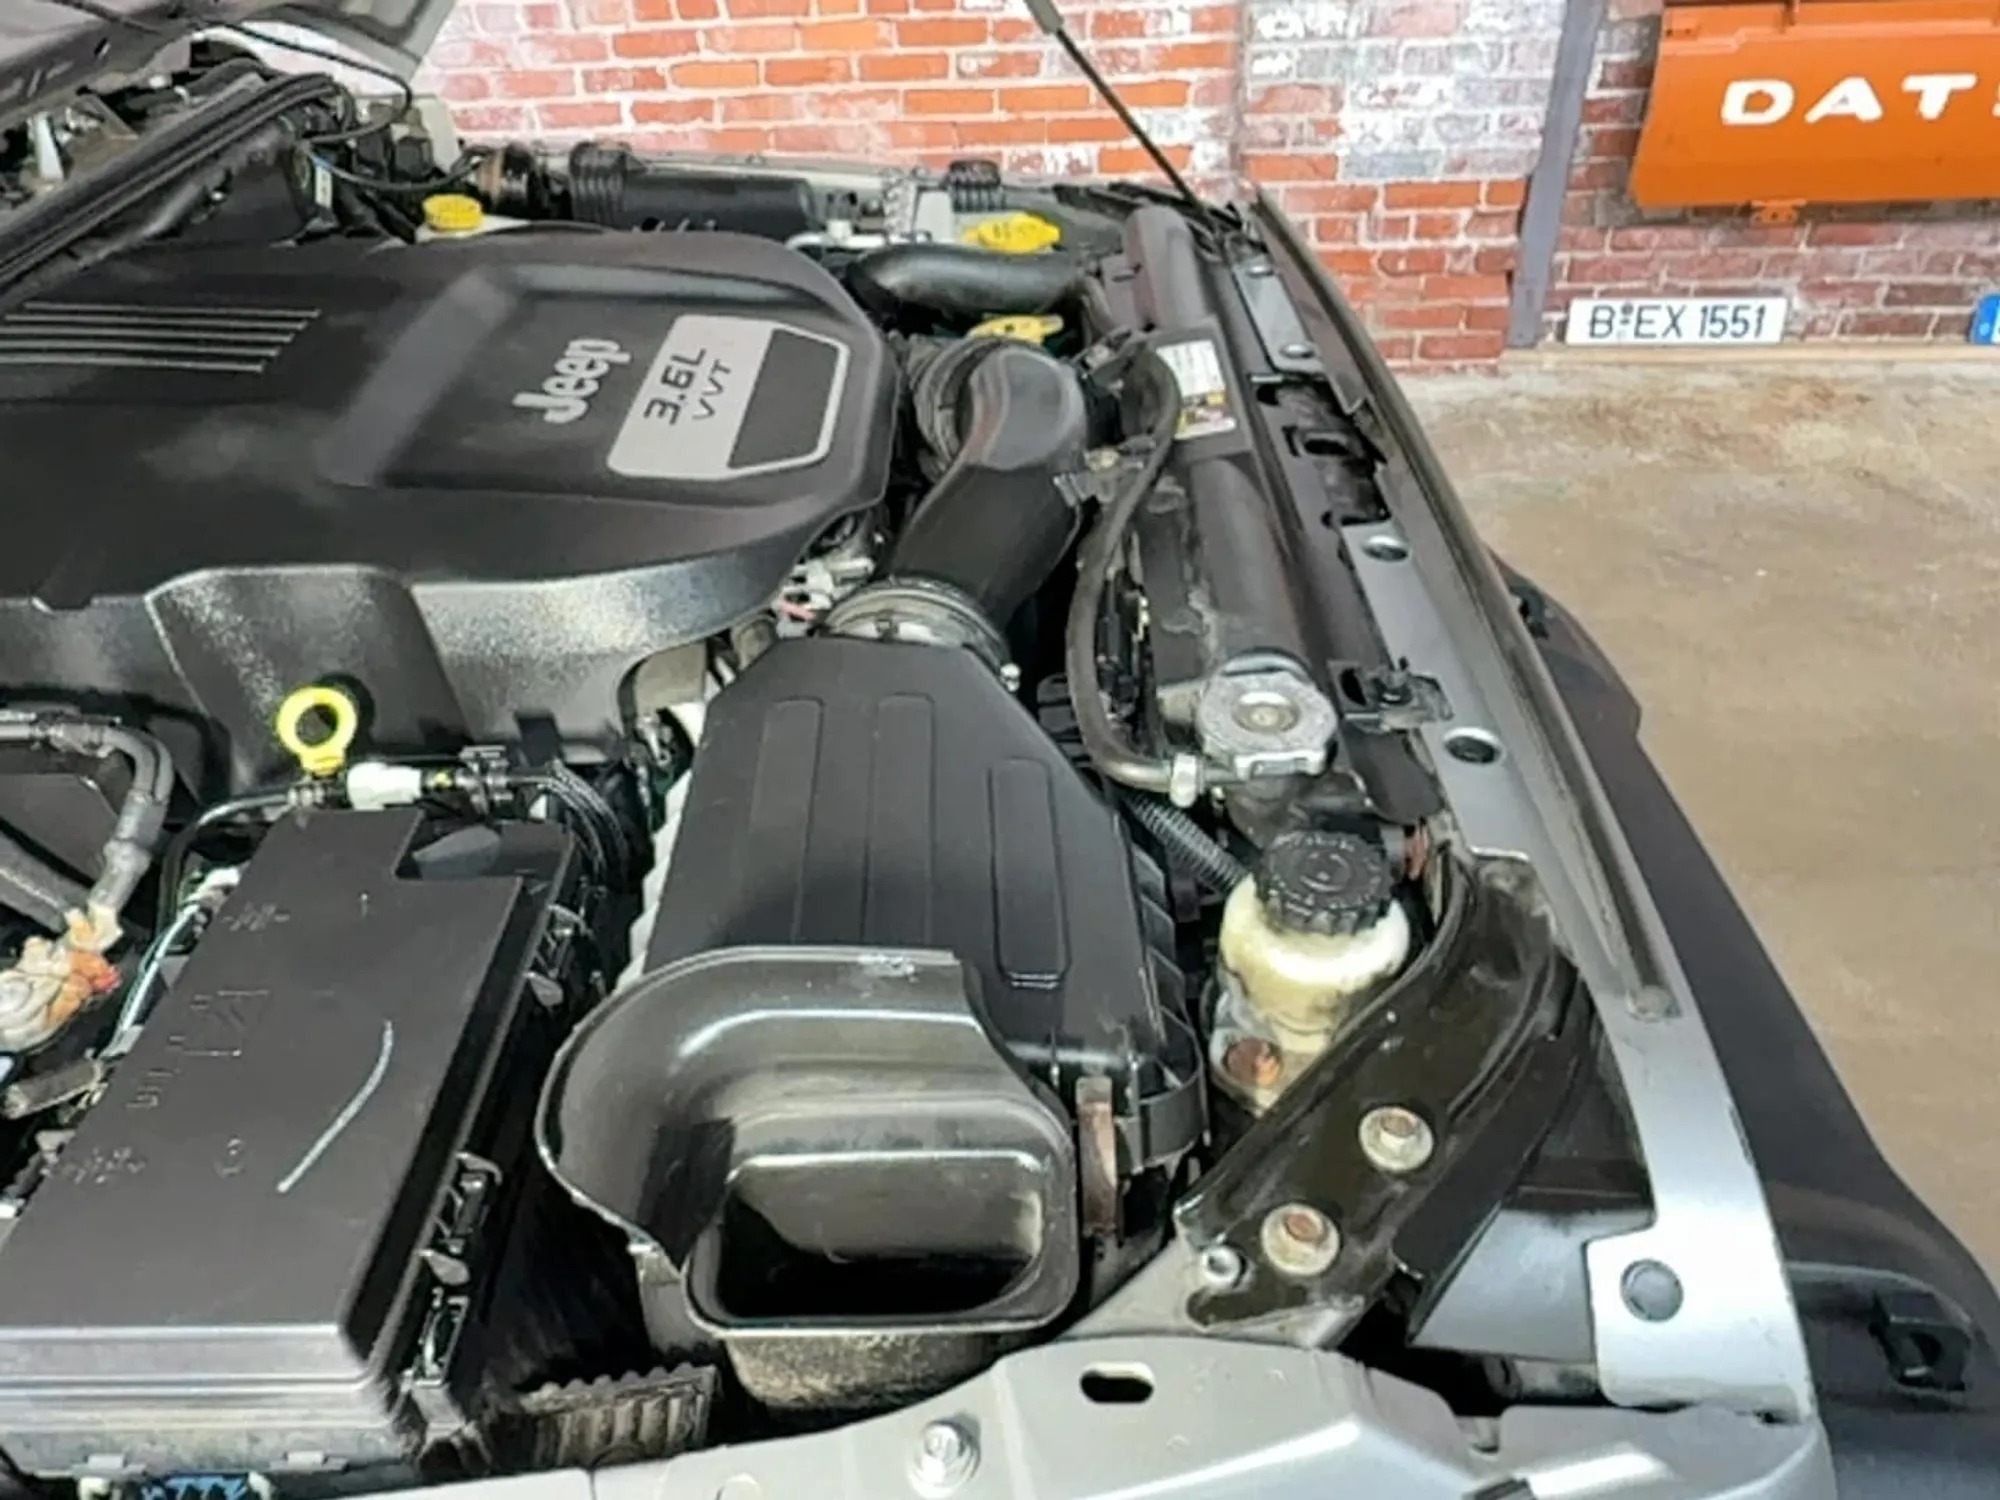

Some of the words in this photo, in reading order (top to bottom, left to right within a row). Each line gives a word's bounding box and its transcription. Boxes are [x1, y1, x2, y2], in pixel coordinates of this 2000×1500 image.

[1721, 73, 2000, 125] DAT
[1699, 304, 1767, 339] 1551
[512, 338, 632, 424] Jeep
[643, 348, 706, 425] 3.6L
[692, 359, 732, 421] VVT
